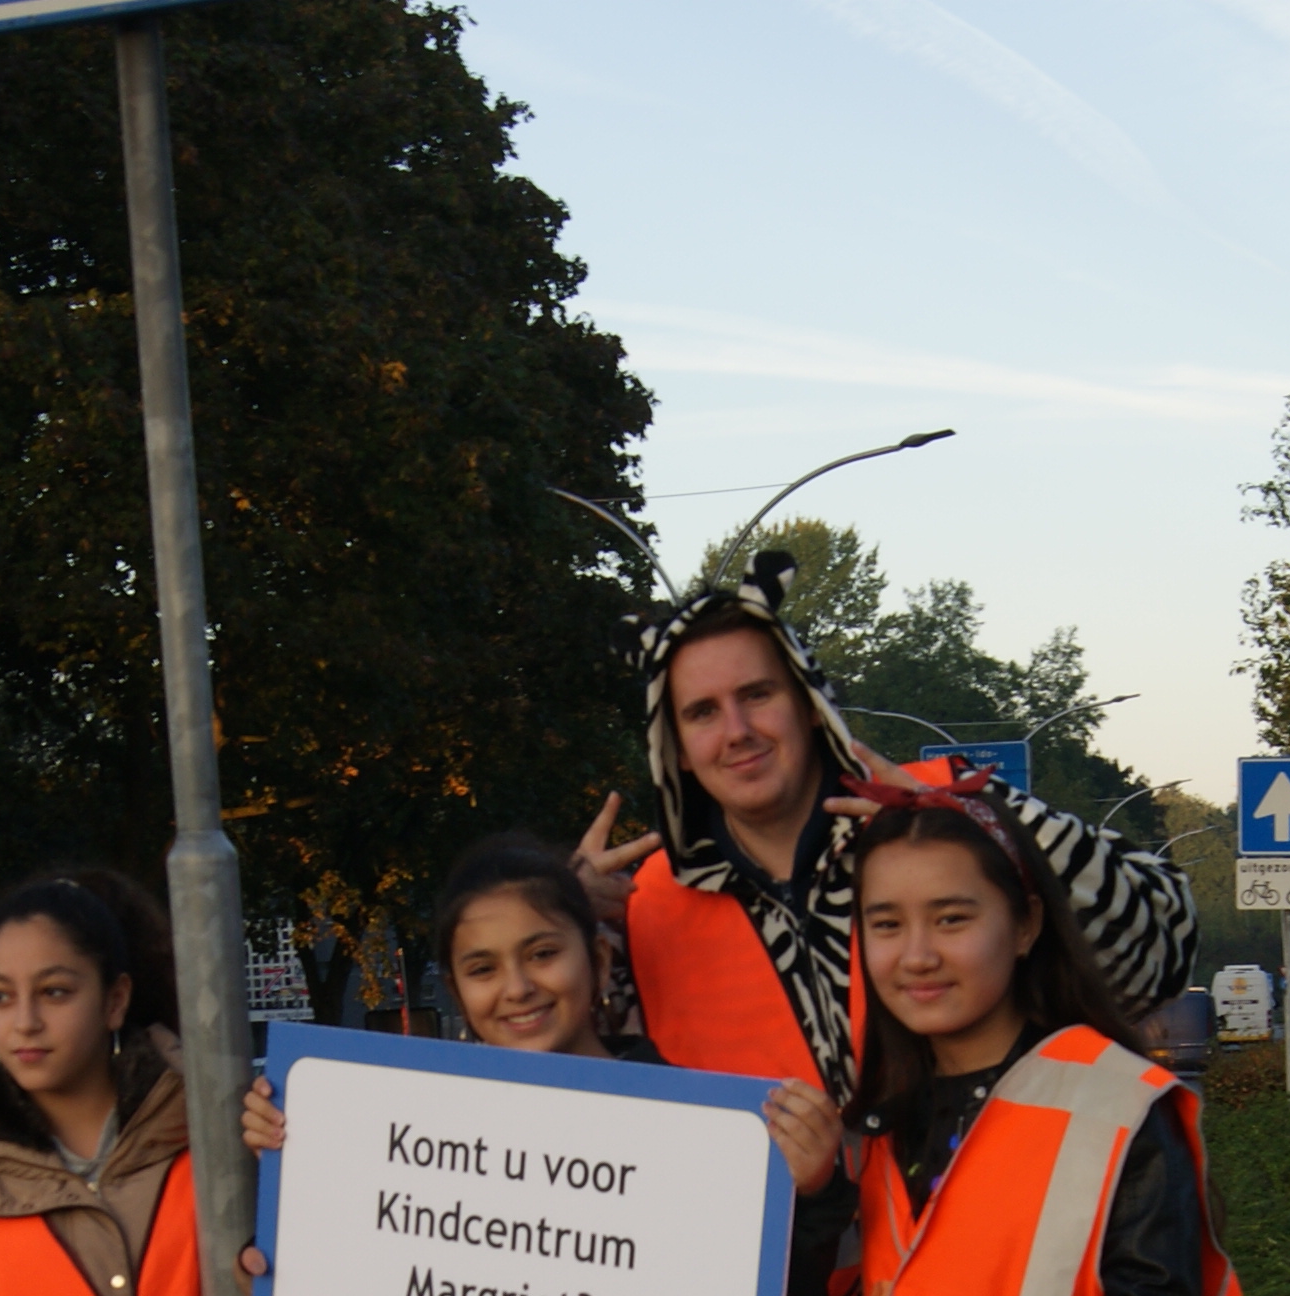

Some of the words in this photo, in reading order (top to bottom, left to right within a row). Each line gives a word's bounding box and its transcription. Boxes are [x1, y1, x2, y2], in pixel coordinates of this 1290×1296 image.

[388, 1122, 488, 1176] Komt
[504, 1149, 526, 1181] u
[543, 1154, 637, 1195] voor
[376, 1190, 636, 1270] Kindcentrum
